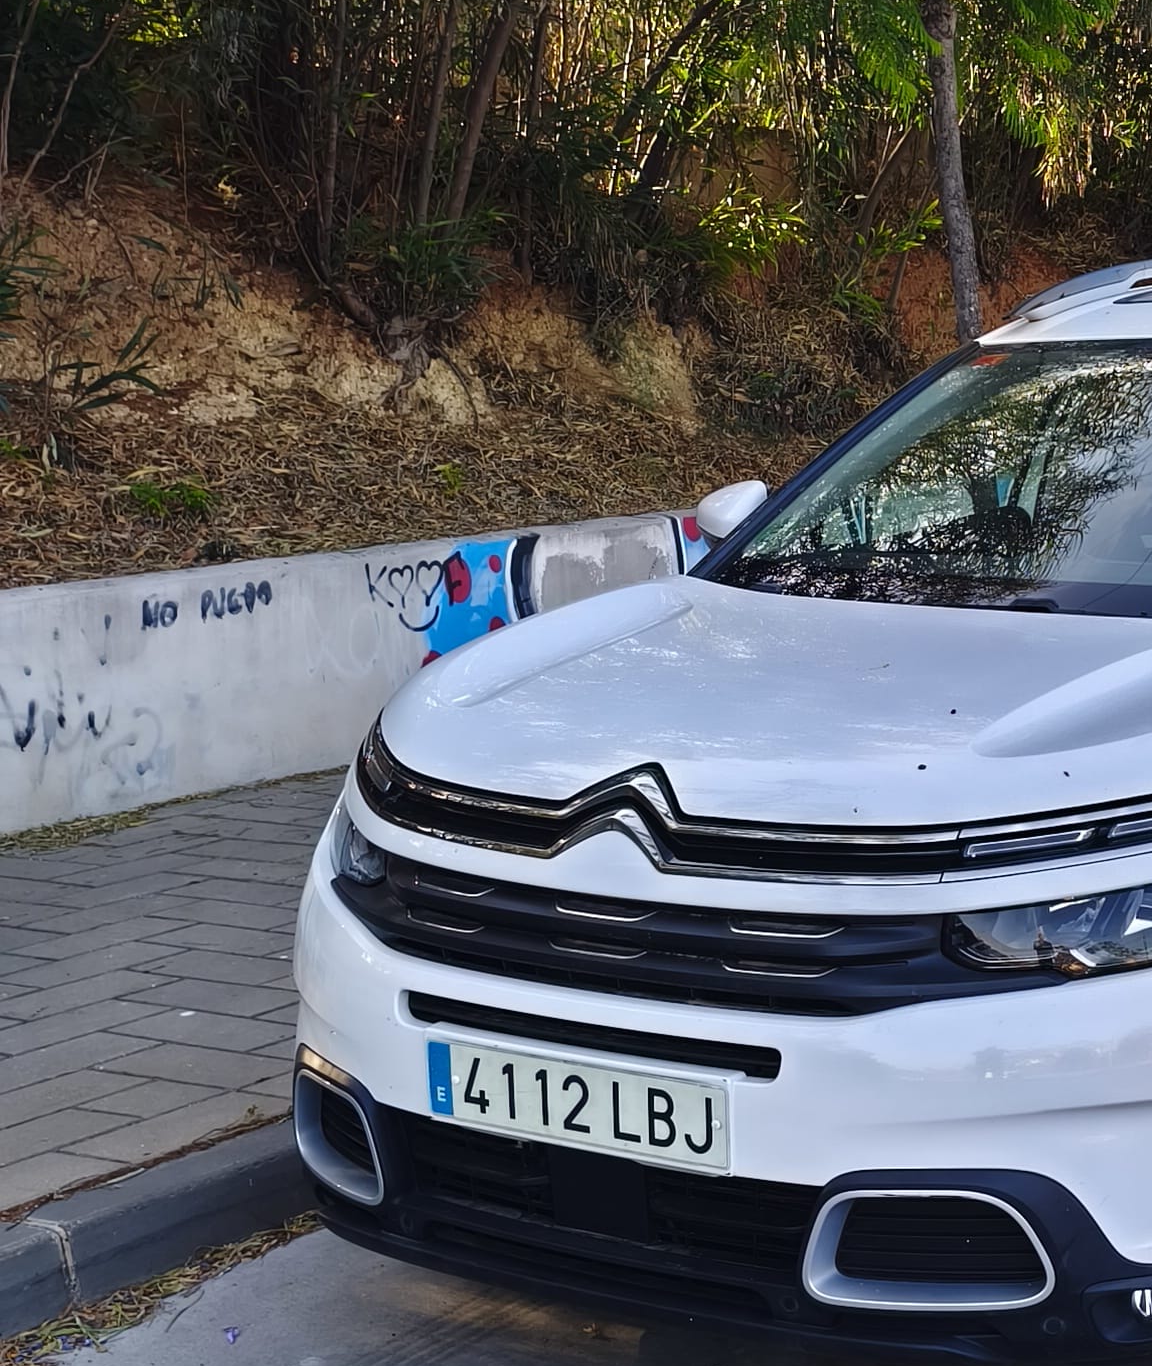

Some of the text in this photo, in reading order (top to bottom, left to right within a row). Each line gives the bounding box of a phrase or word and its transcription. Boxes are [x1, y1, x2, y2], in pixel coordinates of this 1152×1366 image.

[141, 599, 179, 630] NO
[436, 1087, 447, 1103] E
[464, 1057, 714, 1155] 4112 LBJ
